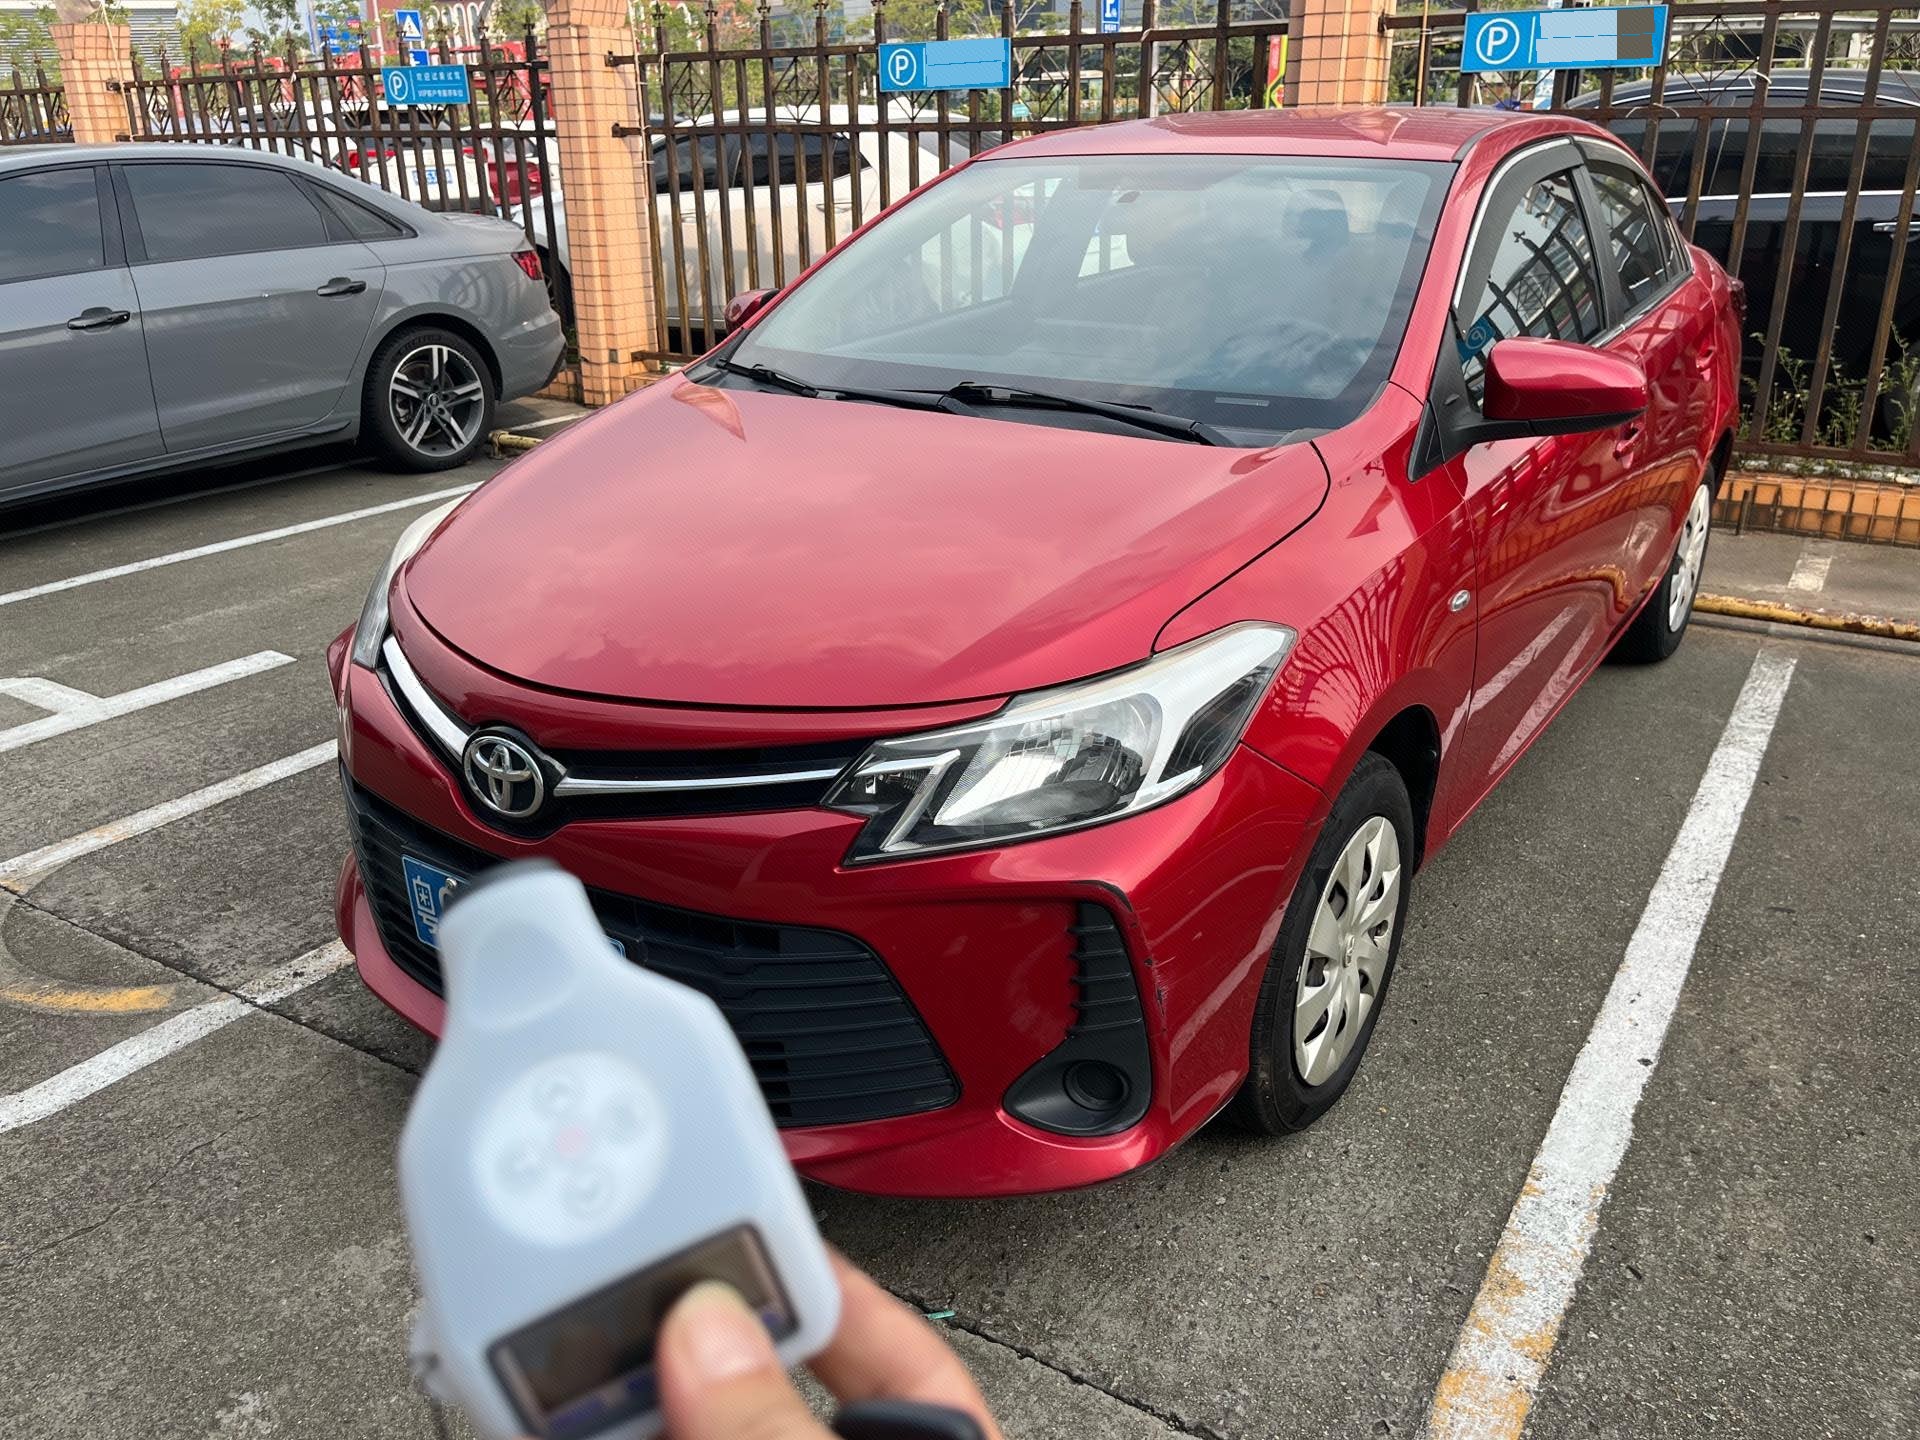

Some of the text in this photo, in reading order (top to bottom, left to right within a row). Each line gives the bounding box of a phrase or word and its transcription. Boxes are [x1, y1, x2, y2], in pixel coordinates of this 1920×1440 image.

[1486, 26, 1508, 57] P
[895, 54, 909, 79] P
[392, 75, 403, 96] P
